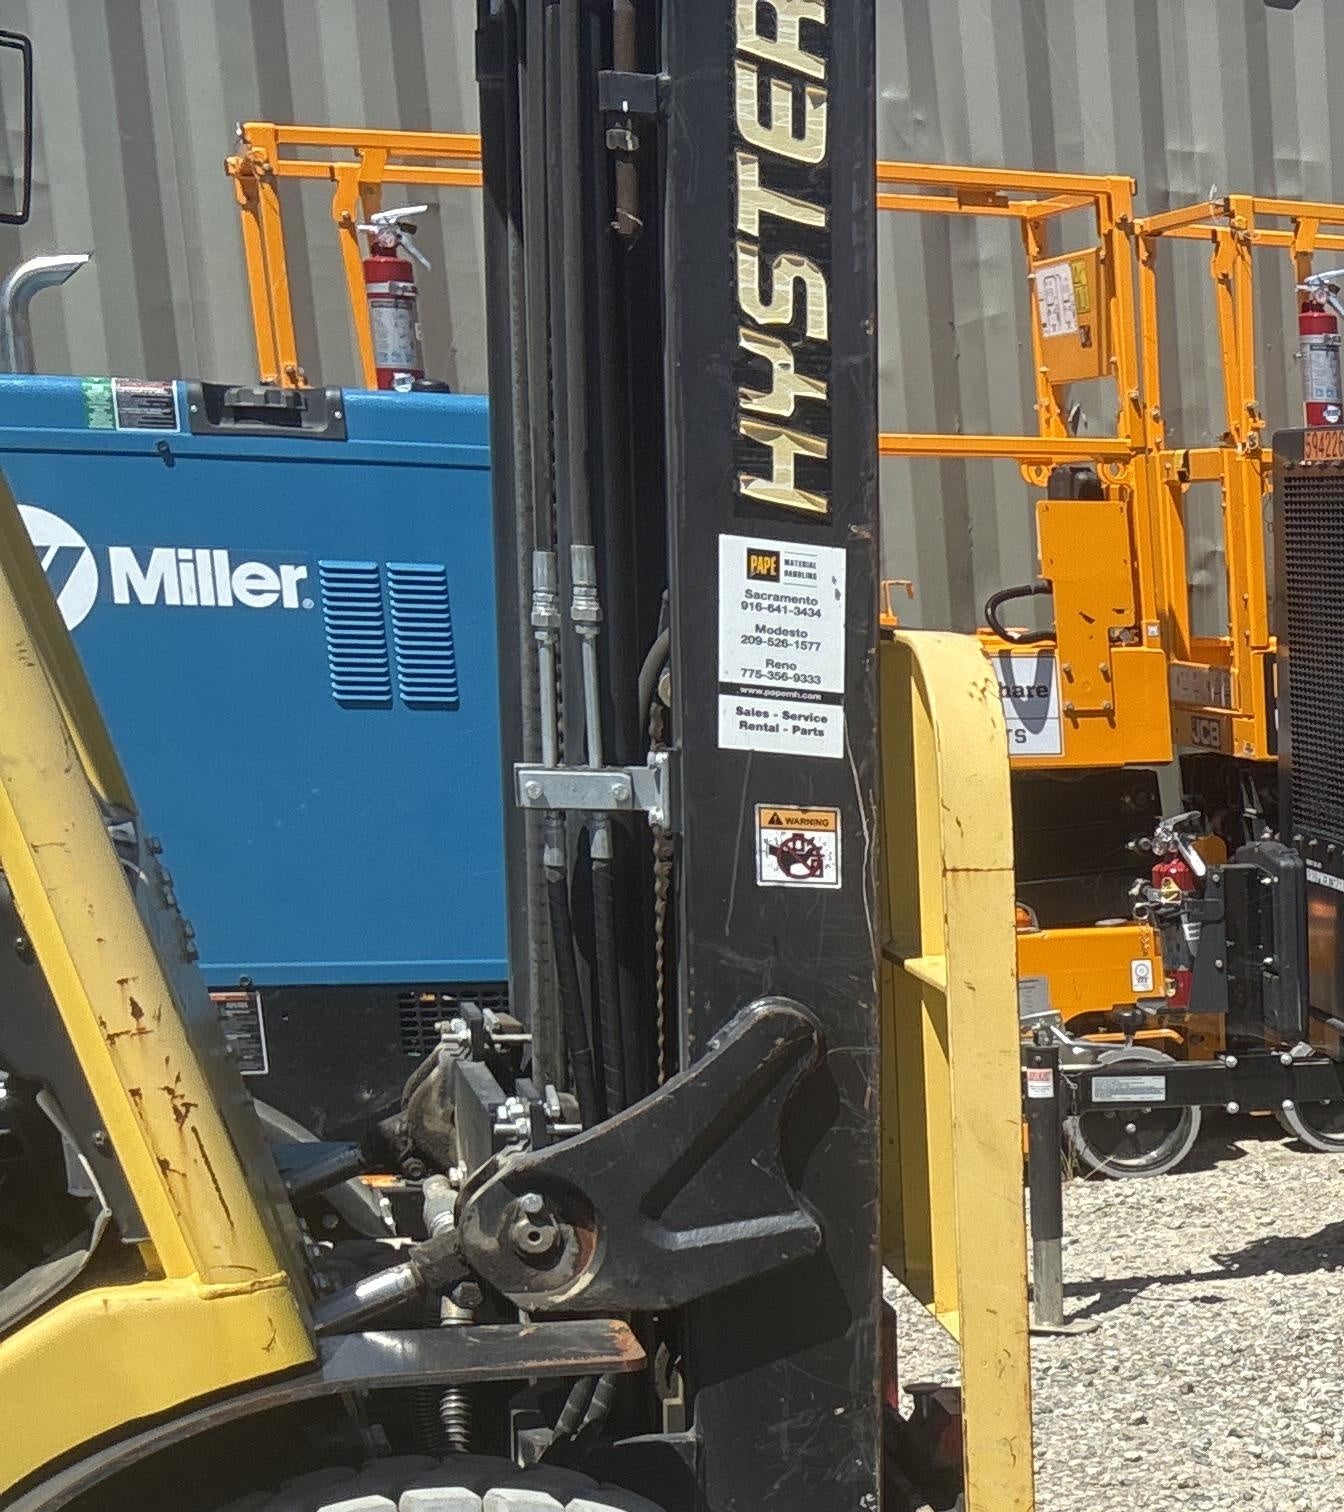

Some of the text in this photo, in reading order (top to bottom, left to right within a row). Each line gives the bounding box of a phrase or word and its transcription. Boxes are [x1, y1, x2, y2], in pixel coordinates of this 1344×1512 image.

[736, 0, 828, 514] HYSTER
[108, 546, 308, 608] Miller
[744, 589, 818, 606] Sacramento
[740, 601, 822, 618] 916-641-3434
[755, 624, 808, 639] Modesto
[740, 635, 822, 651] 209-526-1577
[766, 659, 797, 671] Reno
[740, 668, 822, 684] 775-356-9333
[1000, 682, 1049, 699] hare
[736, 706, 769, 718] Sales
[782, 711, 828, 723] Service
[739, 720, 779, 733] Rental
[792, 725, 825, 737] Parts
[785, 817, 829, 827] WARNING
